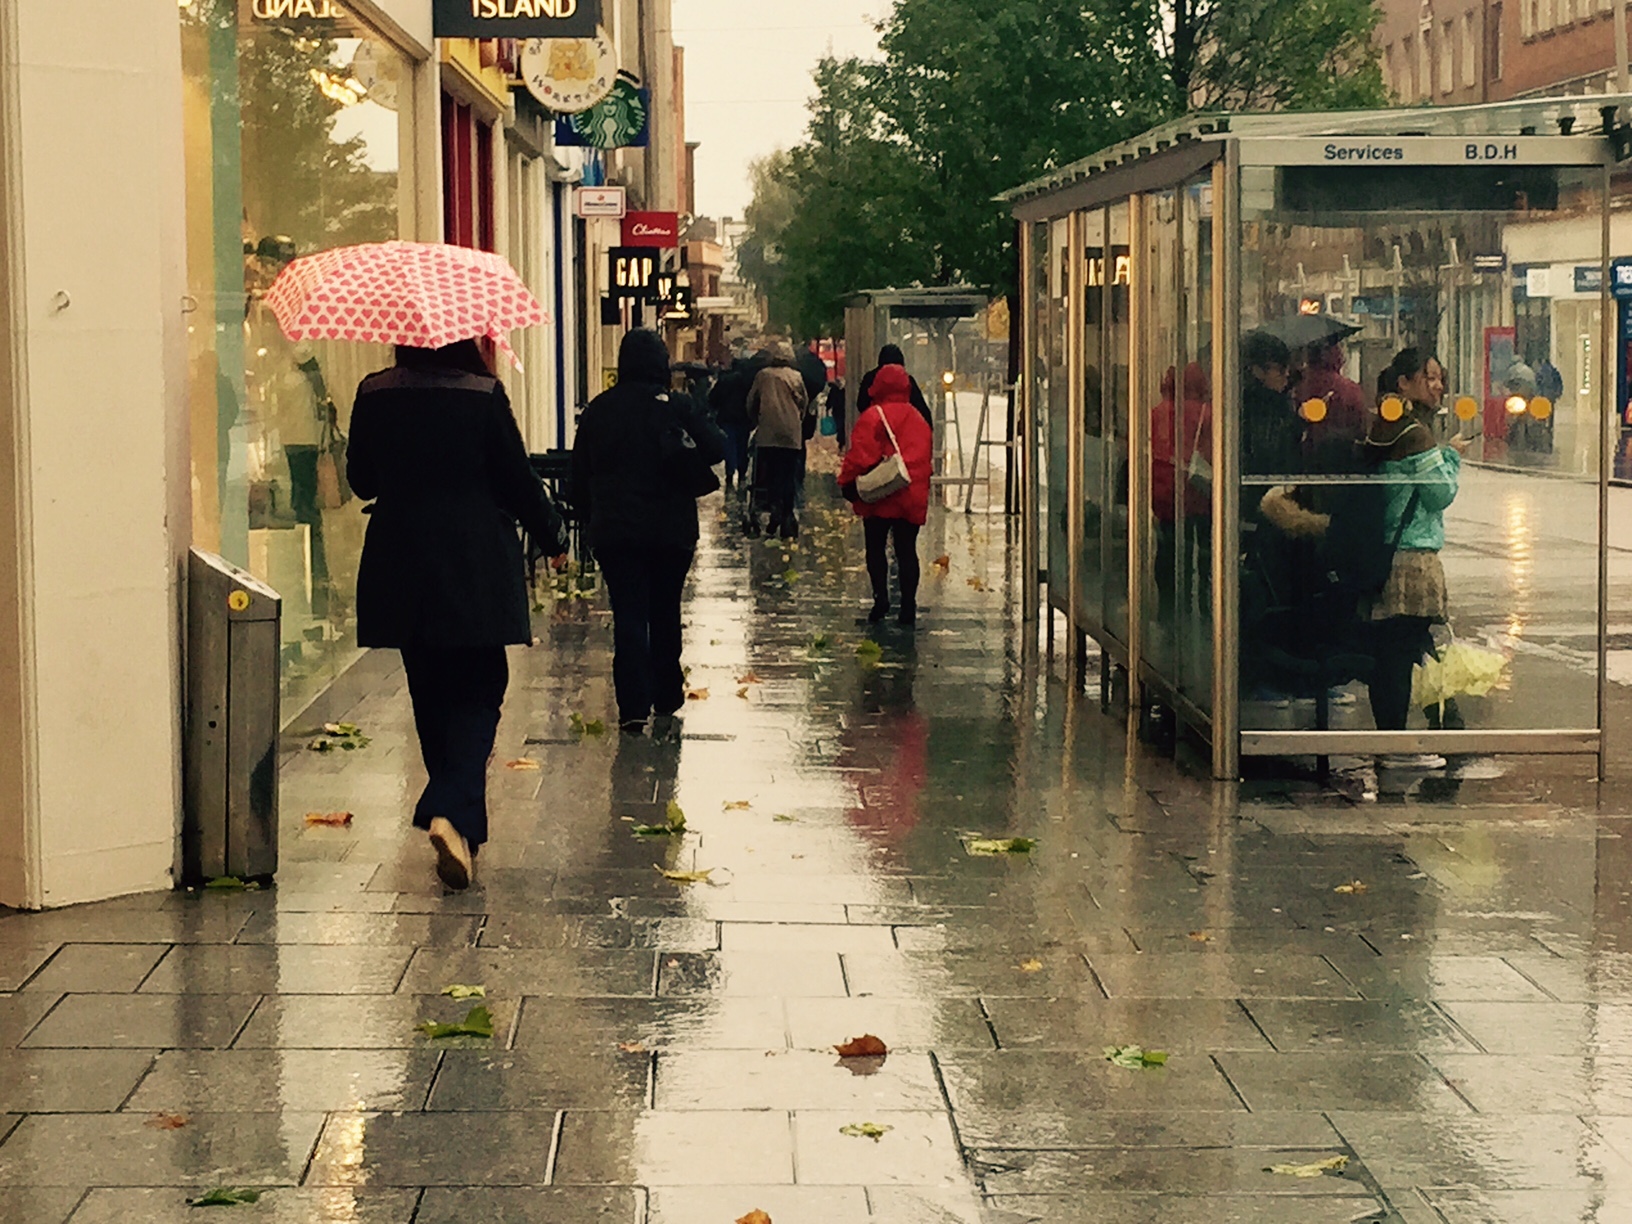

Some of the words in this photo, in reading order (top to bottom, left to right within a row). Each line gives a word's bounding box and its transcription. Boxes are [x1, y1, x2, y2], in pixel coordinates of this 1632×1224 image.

[472, 0, 577, 18] ISLAND
[1324, 144, 1404, 160] Services
[1465, 144, 1518, 160] B.D.H
[616, 257, 652, 287] GAP
